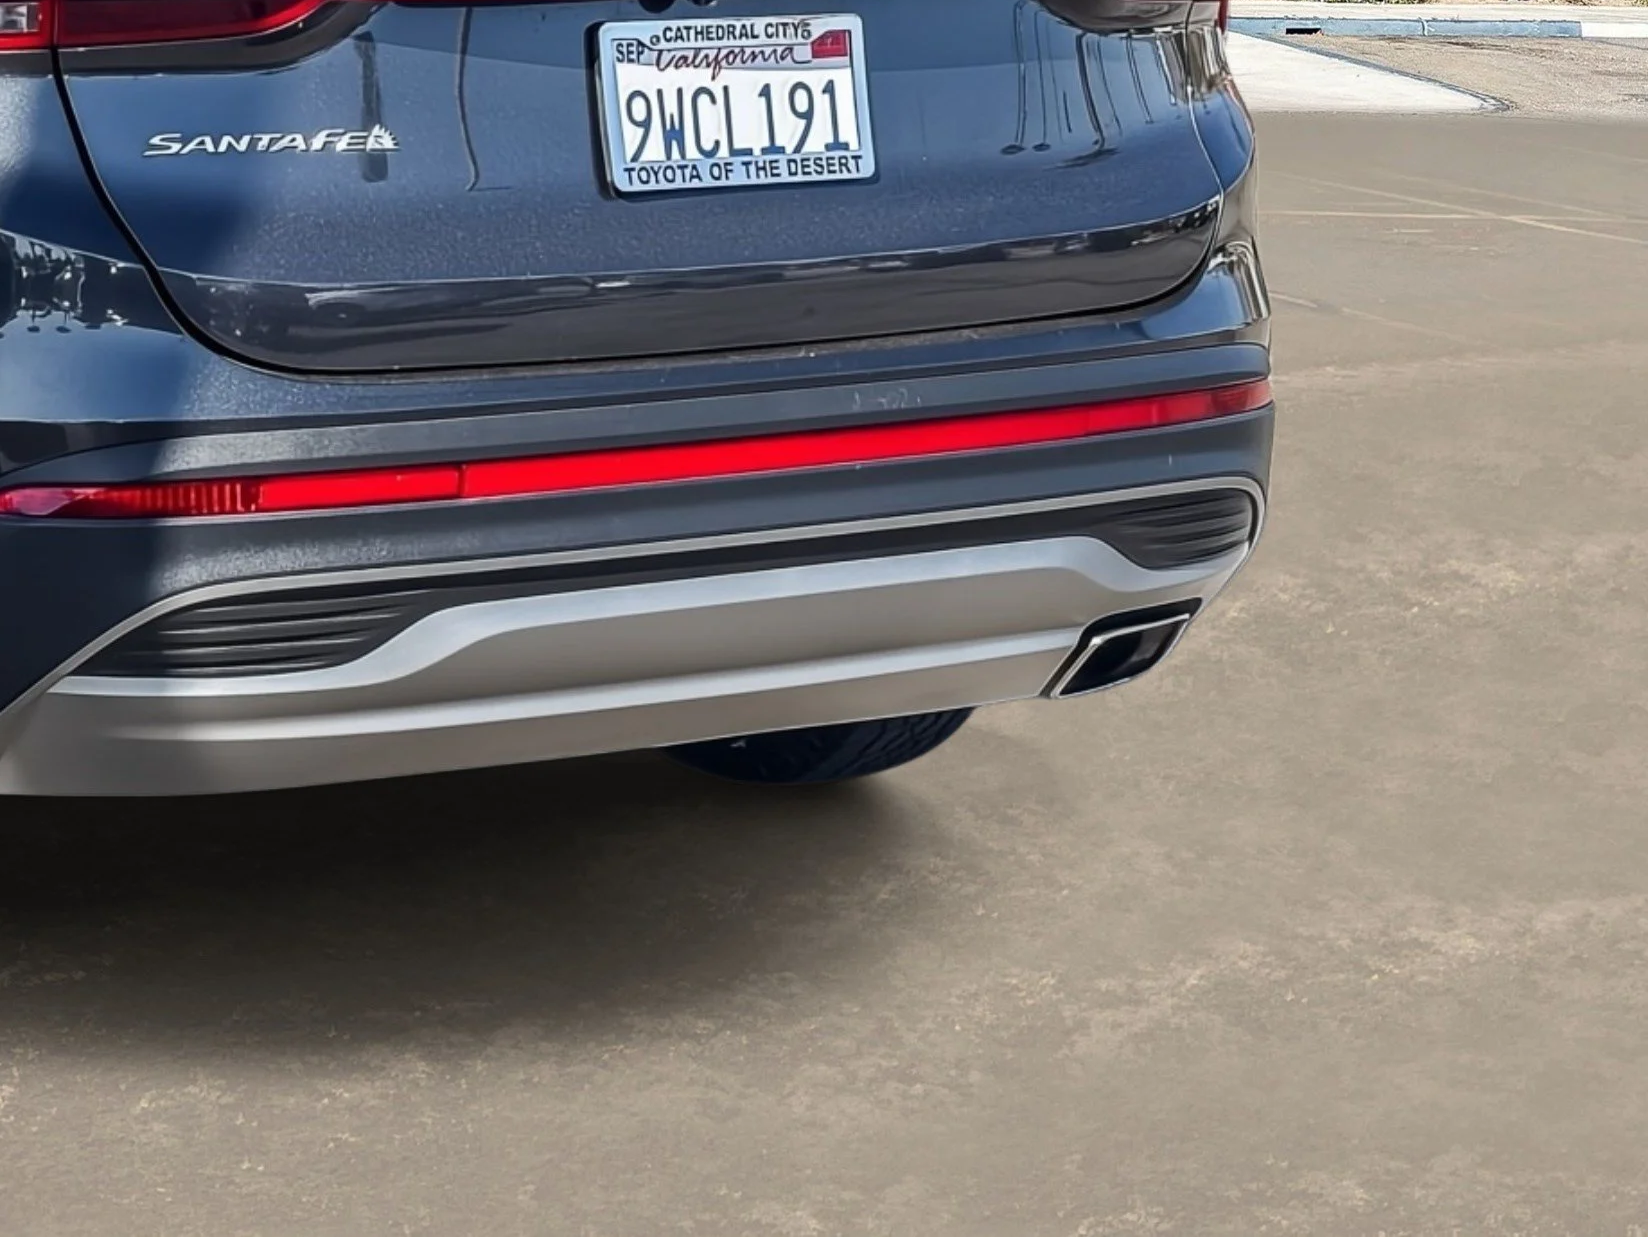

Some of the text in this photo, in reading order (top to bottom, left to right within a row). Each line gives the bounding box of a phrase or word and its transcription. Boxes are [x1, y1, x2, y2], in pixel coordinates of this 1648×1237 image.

[662, 21, 801, 45] CATHEDRAL CITY
[615, 42, 645, 63] SEP
[654, 45, 812, 81] California
[625, 78, 851, 163] 9WCL191
[623, 154, 863, 187] TOYOTA OF THE DESERT
